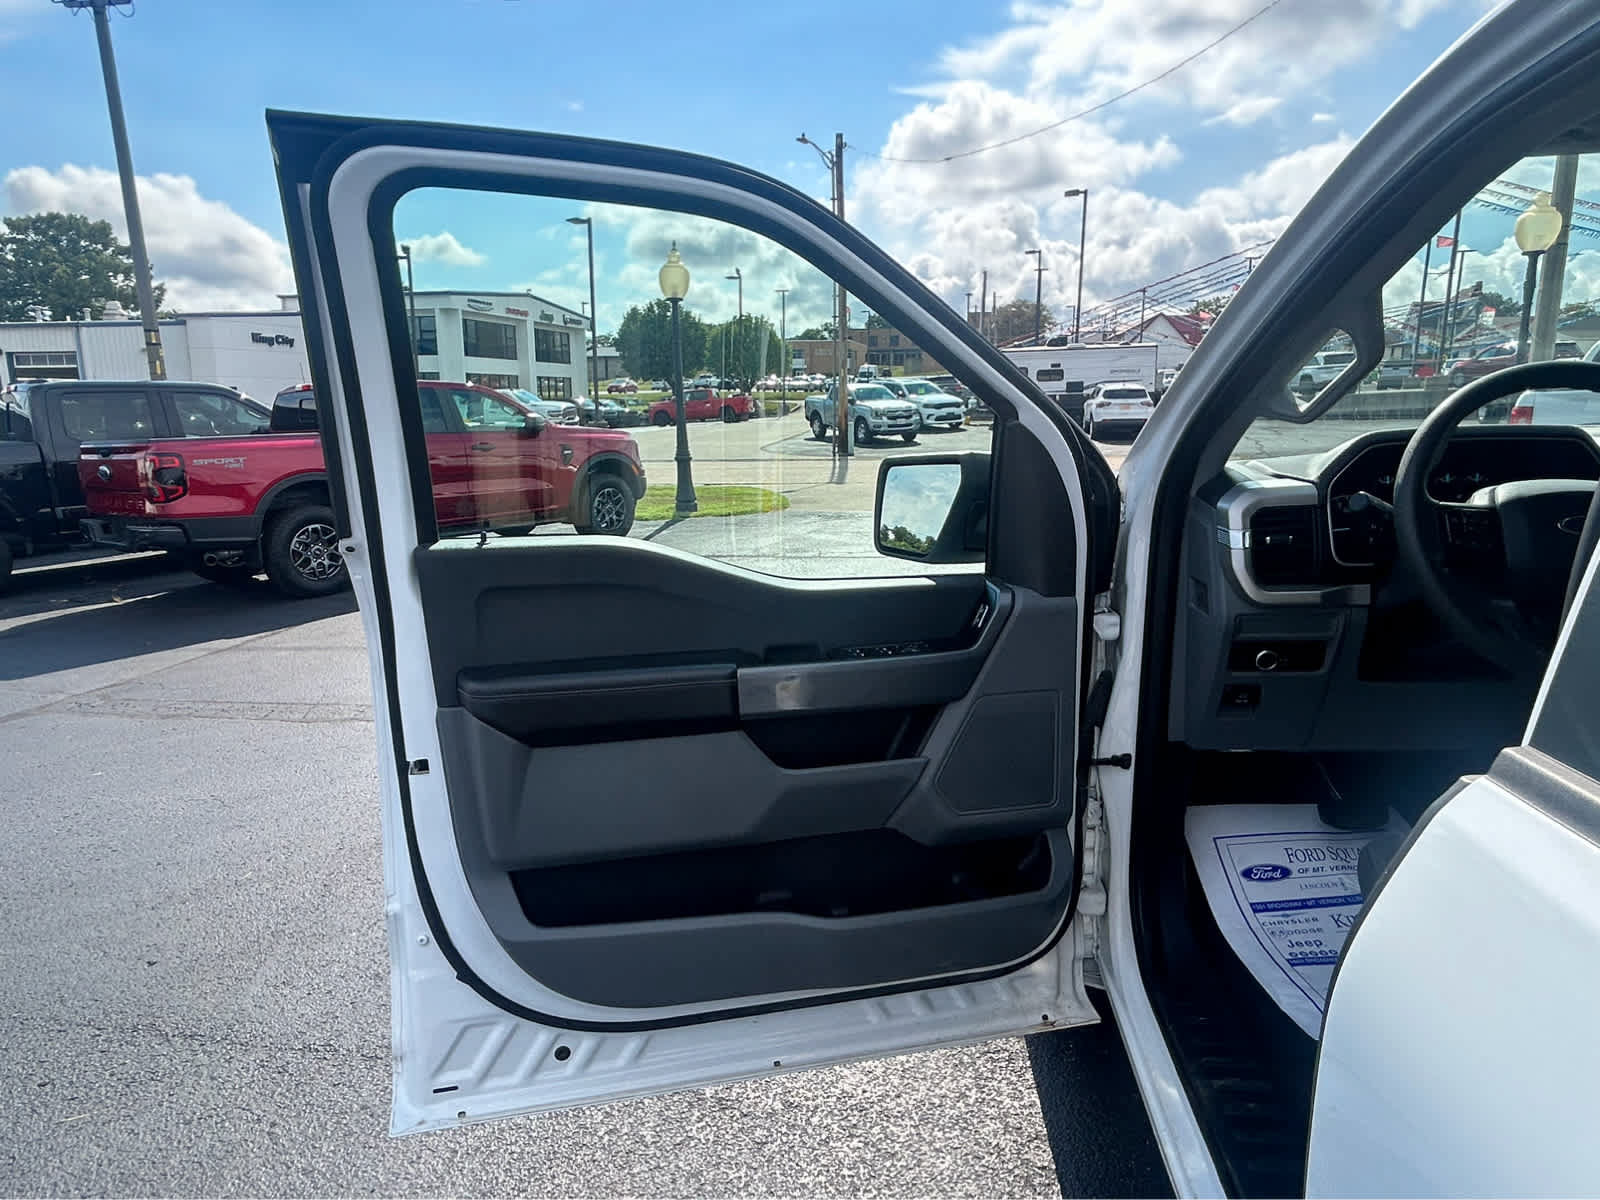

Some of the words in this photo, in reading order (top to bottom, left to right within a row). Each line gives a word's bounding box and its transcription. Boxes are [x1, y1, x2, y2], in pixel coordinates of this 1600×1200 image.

[275, 334, 295, 348] City
[192, 456, 248, 465] SPORT
[1284, 847, 1327, 863] FORD
[1251, 866, 1282, 879] Ford
[1329, 864, 1358, 872] VERNO
[1262, 917, 1320, 927] CHRYSLER
[1287, 939, 1323, 949] Jeep
